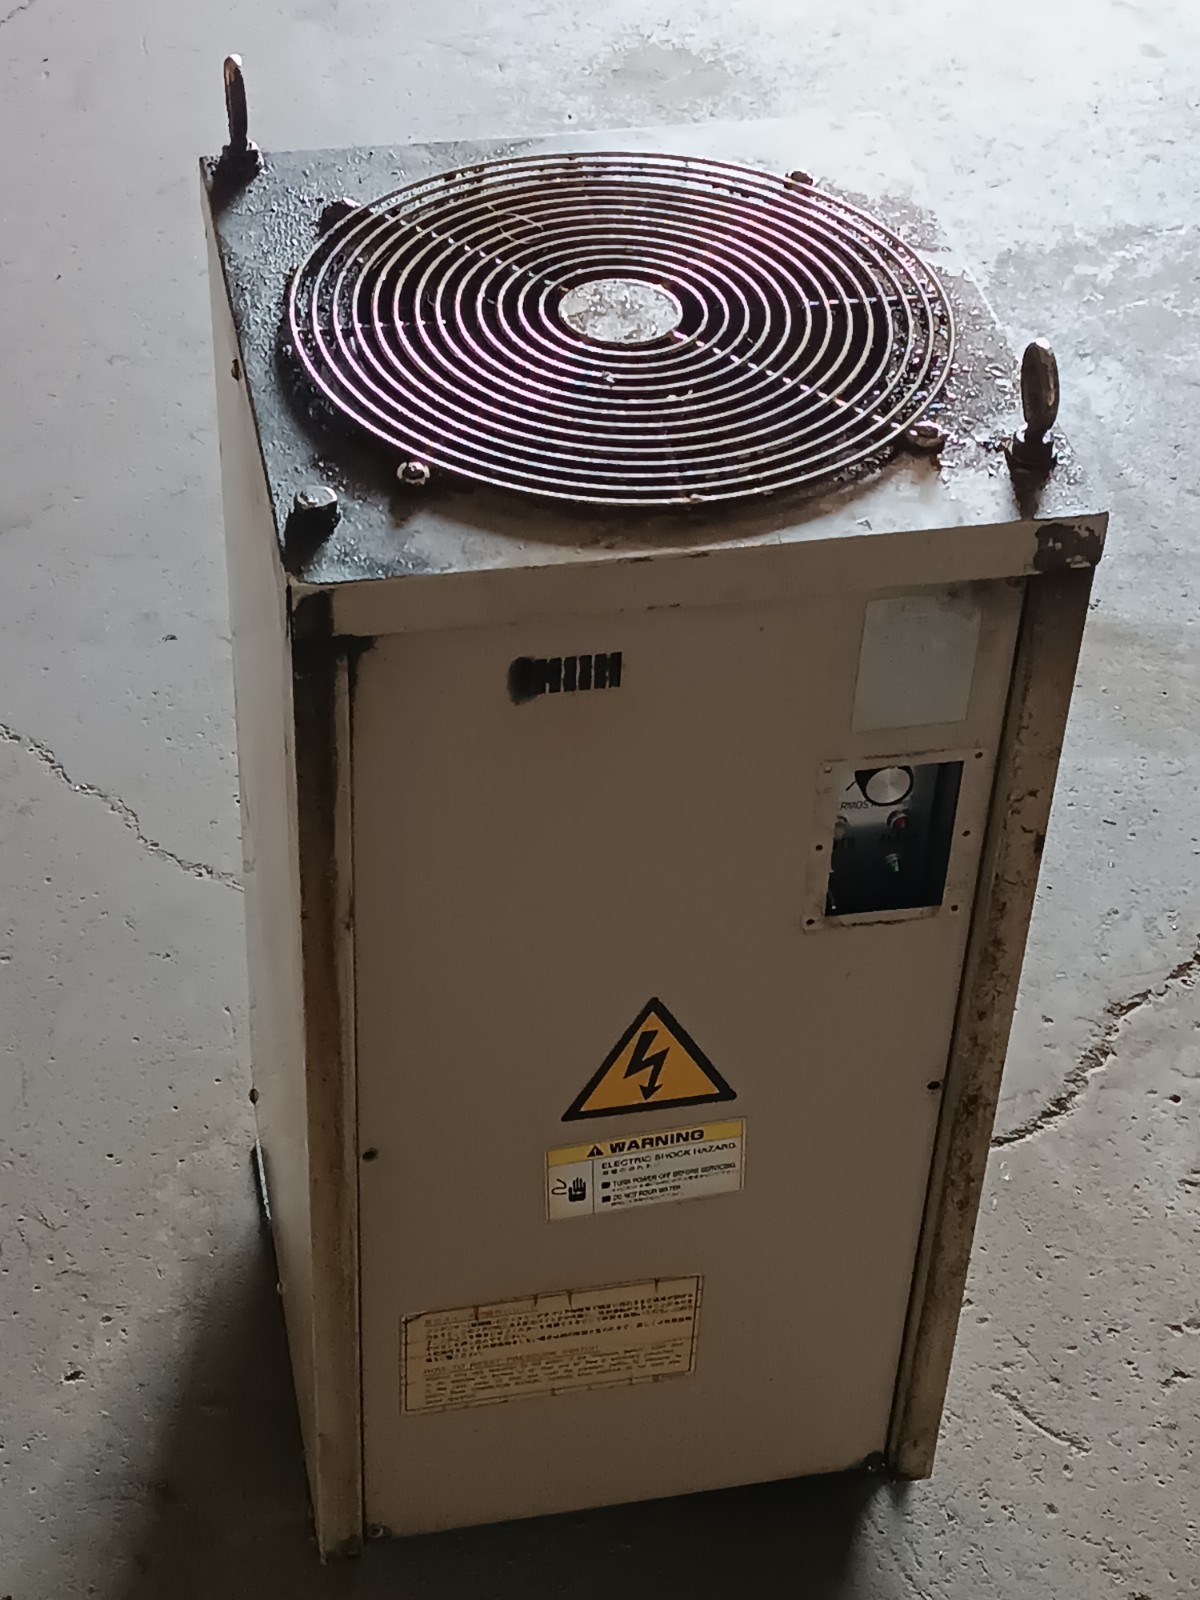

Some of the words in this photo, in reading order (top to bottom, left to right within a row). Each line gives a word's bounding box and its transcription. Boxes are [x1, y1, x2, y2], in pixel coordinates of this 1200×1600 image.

[609, 1129, 705, 1154] WARNING
[601, 1155, 652, 1170] ELECTRIC
[654, 1149, 691, 1161] SHOCK
[693, 1142, 737, 1155] HAZARD
